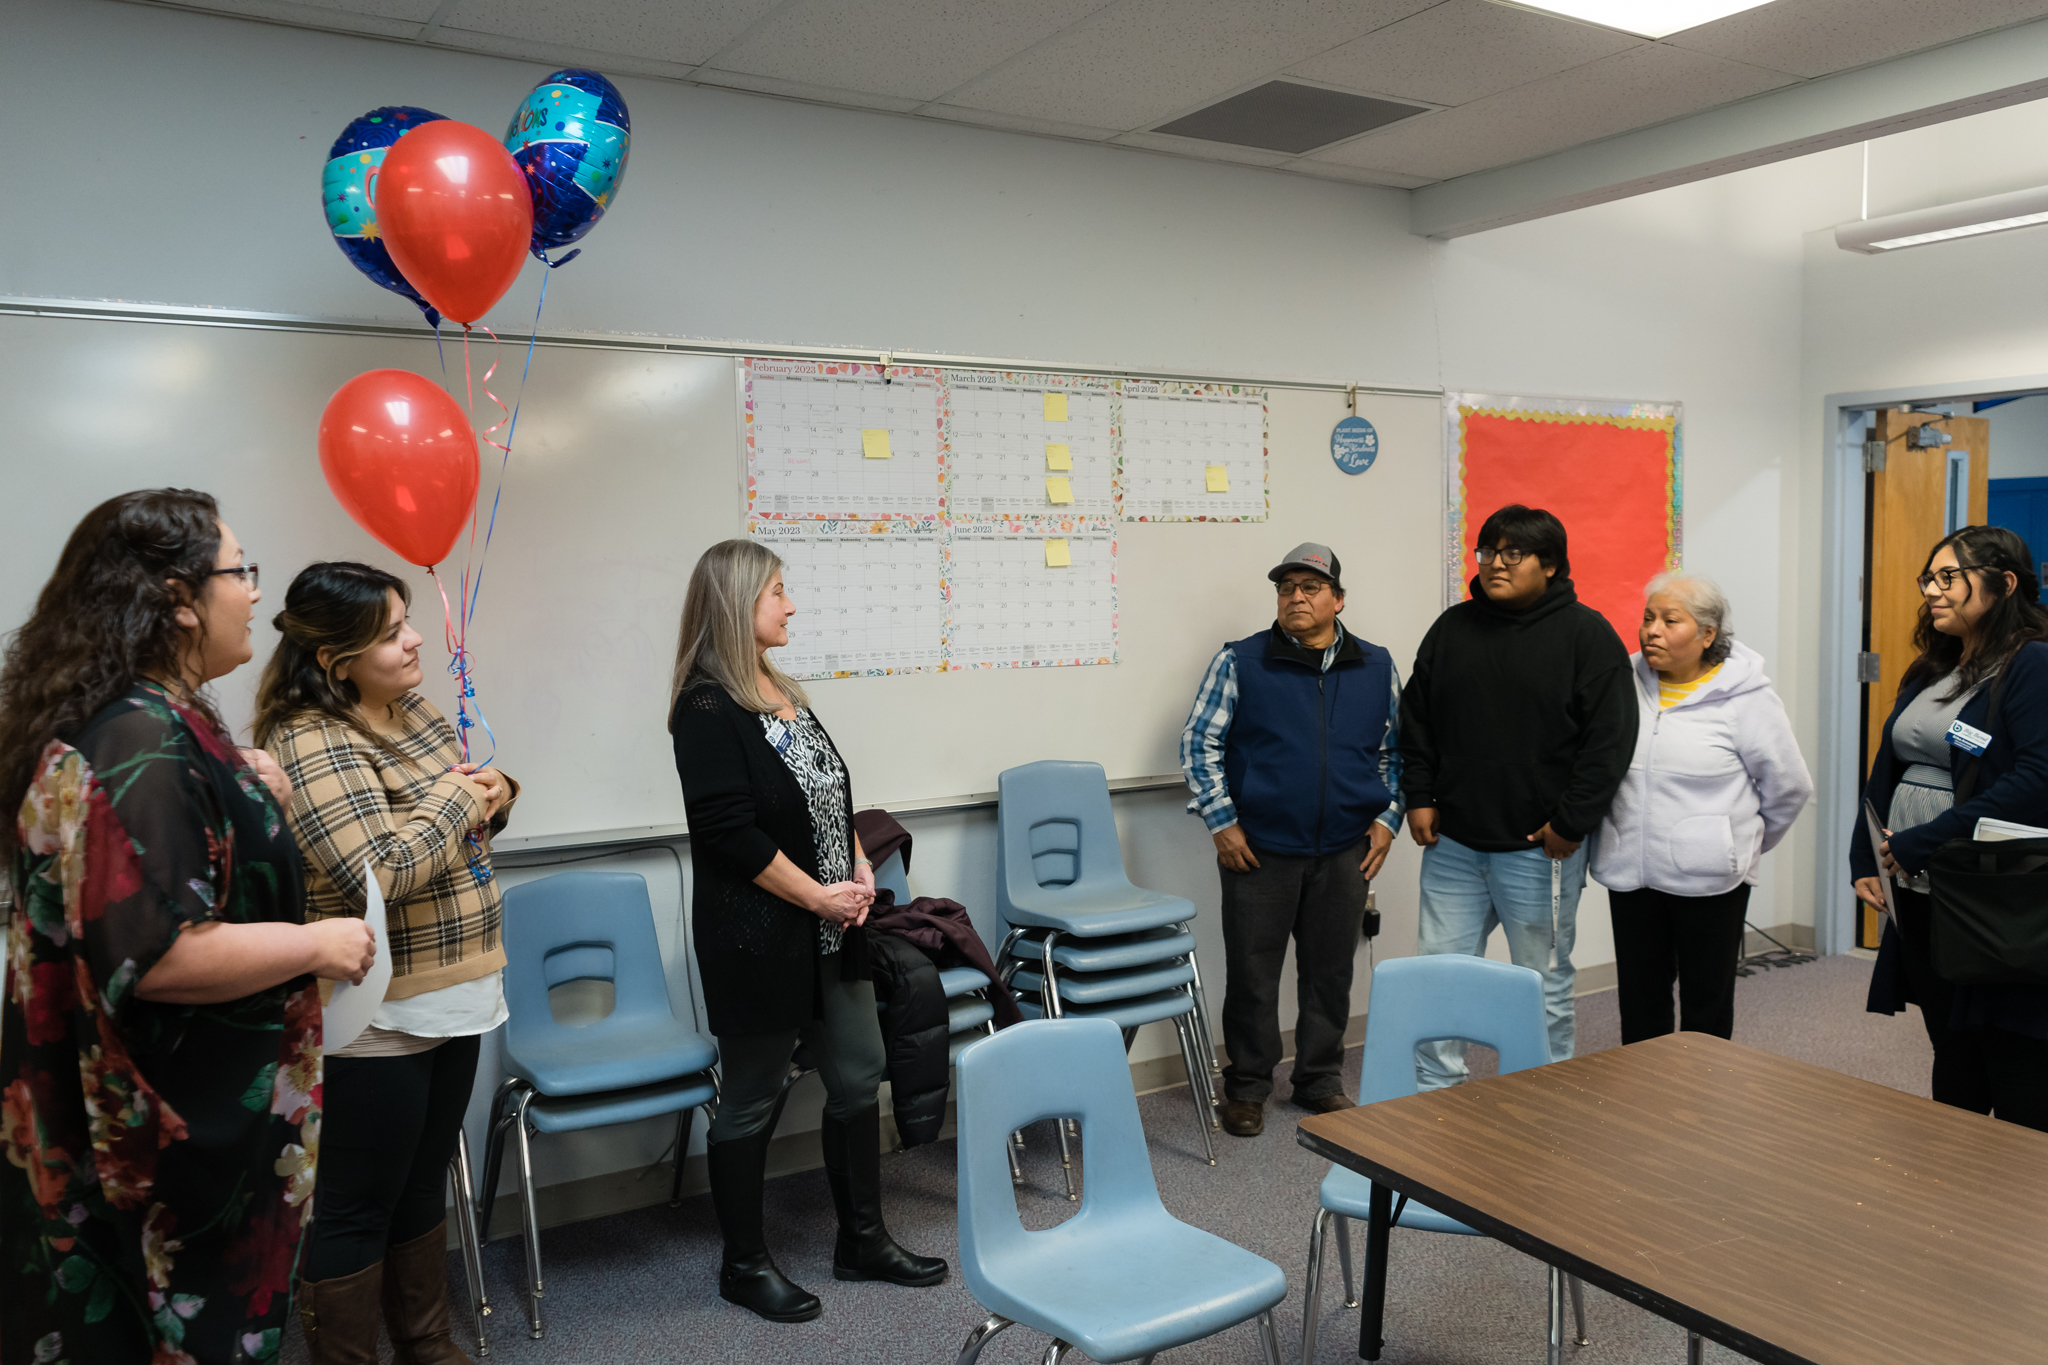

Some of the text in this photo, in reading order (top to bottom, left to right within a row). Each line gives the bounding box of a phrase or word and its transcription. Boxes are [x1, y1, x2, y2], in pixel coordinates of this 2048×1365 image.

[753, 363, 816, 375] February 2023
[951, 374, 975, 382] March
[1123, 385, 1139, 393] April
[1348, 453, 1369, 468] Love
[758, 527, 777, 537] May
[953, 526, 971, 535] June
